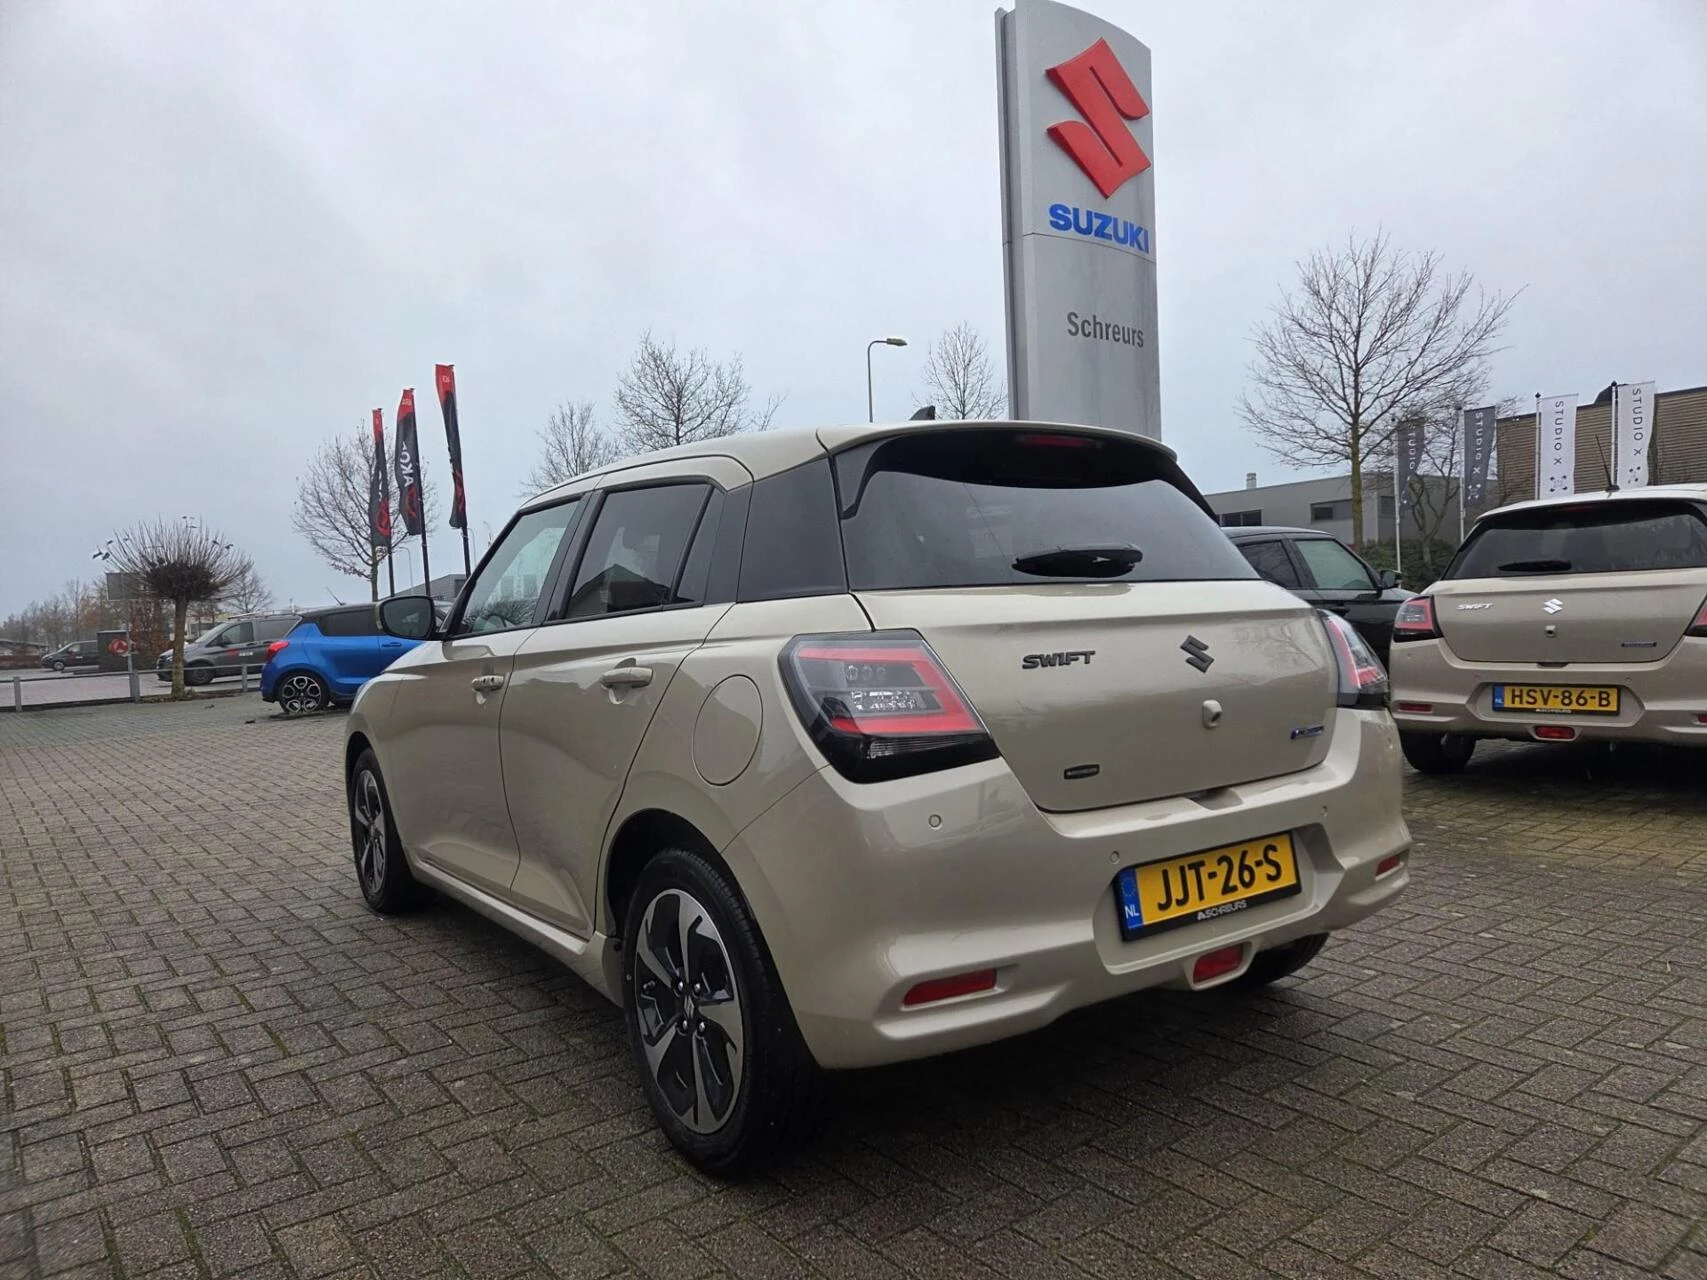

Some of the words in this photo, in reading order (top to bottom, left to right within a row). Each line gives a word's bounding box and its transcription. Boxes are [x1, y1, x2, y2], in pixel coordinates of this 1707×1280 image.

[1049, 203, 1149, 253] SUZUKI
[1067, 311, 1144, 348] Schreurs
[1554, 401, 1564, 451] STUDIO
[1633, 388, 1644, 441] STUDIO
[1475, 411, 1484, 461] STUDIO
[1553, 457, 1562, 465] X
[1633, 448, 1641, 456] X
[1473, 466, 1481, 474] X
[1456, 602, 1494, 610] SWIFT
[1022, 650, 1096, 669] SWIFT
[1511, 688, 1611, 708] HSV-86-B
[1124, 904, 1140, 918] NL
[1157, 844, 1282, 911] JJT-26-S
